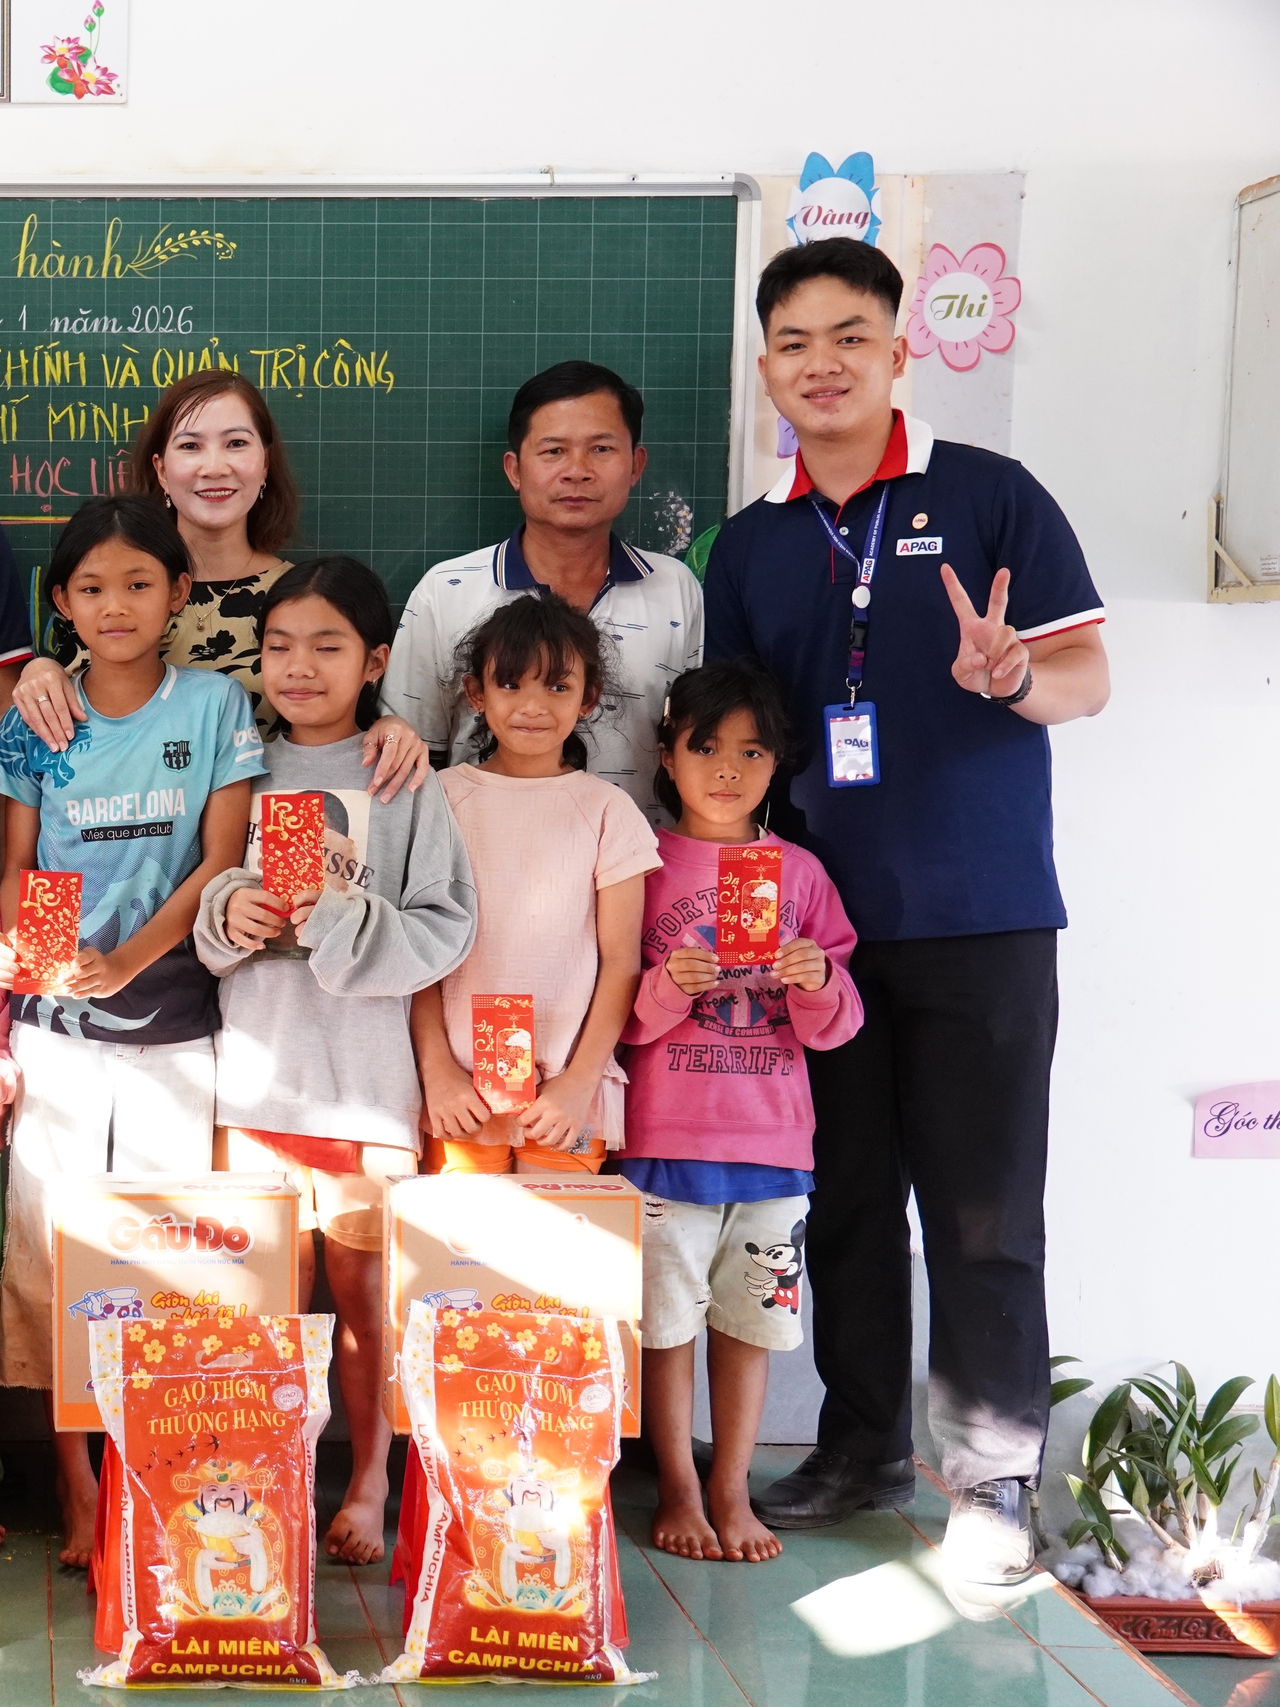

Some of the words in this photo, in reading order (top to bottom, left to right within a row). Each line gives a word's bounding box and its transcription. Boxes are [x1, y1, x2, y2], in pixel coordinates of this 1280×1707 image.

[11, 213, 128, 279] hành
[19, 305, 27, 330] 1
[49, 308, 123, 334] năm
[127, 305, 194, 334] 2026
[930, 293, 988, 320] Thi
[102, 343, 140, 389] VÀ
[313, 338, 395, 394] CÔNG
[900, 541, 937, 553] APAG
[862, 559, 873, 582] APAG
[66, 787, 186, 826] BARCELONA
[82, 828, 104, 840] Més
[106, 829, 130, 840] que
[133, 827, 147, 837] un
[149, 824, 172, 835] club
[724, 1027, 734, 1036] OF
[1204, 1101, 1258, 1138] Góc
[193, 1290, 220, 1307] dai
[164, 1381, 206, 1410] GẠO
[210, 1379, 267, 1403] THƠM
[475, 1372, 516, 1396] GẠO
[521, 1374, 574, 1407] THƠM
[233, 1408, 286, 1434] HẠNG
[540, 1411, 594, 1438] HẠNG
[171, 1638, 211, 1656] LÀI
[218, 1637, 281, 1656] MIÊN
[471, 1626, 509, 1646] LÀI
[518, 1631, 579, 1651] MIÊN
[151, 1661, 299, 1676] CAMPUCHIA
[448, 1649, 595, 1673] CAMPUCHIA
